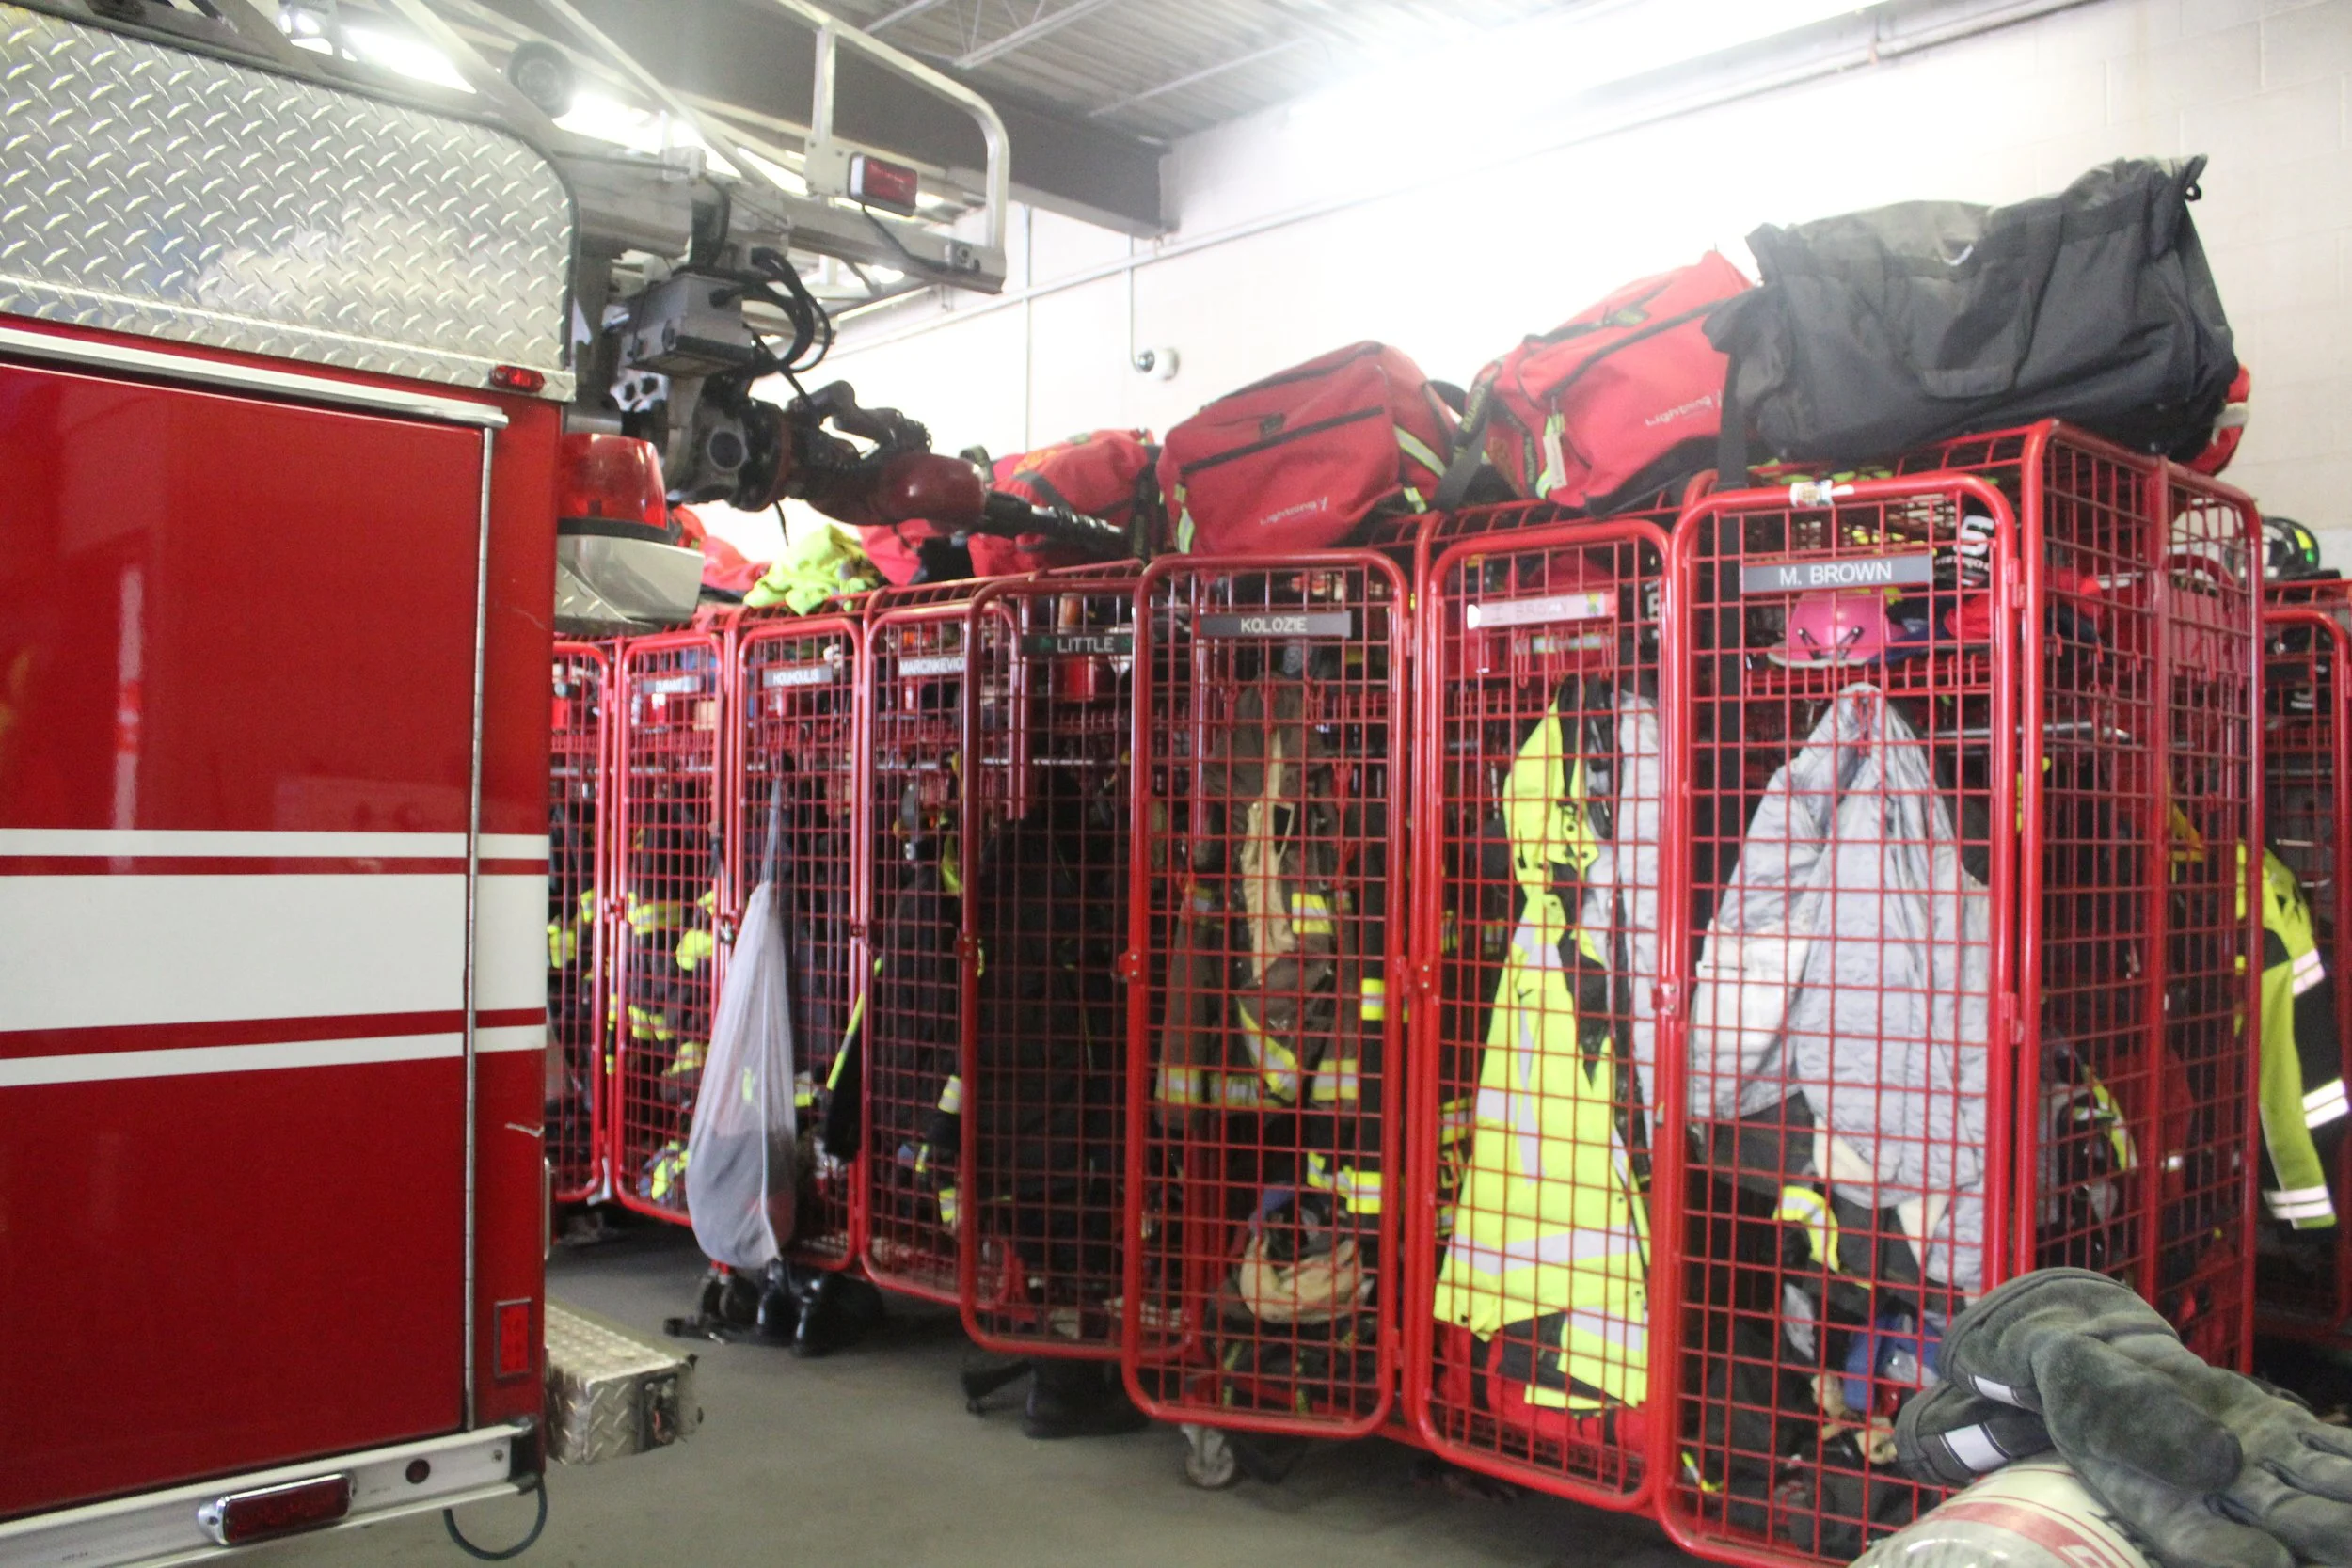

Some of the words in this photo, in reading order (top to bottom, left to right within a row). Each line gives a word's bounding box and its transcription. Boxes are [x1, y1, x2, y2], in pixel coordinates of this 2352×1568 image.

[1780, 567, 1802, 586] M.
[1809, 561, 1893, 585] BROWN
[1240, 616, 1308, 633] KOLOZIE
[1057, 636, 1114, 653] LITTLE
